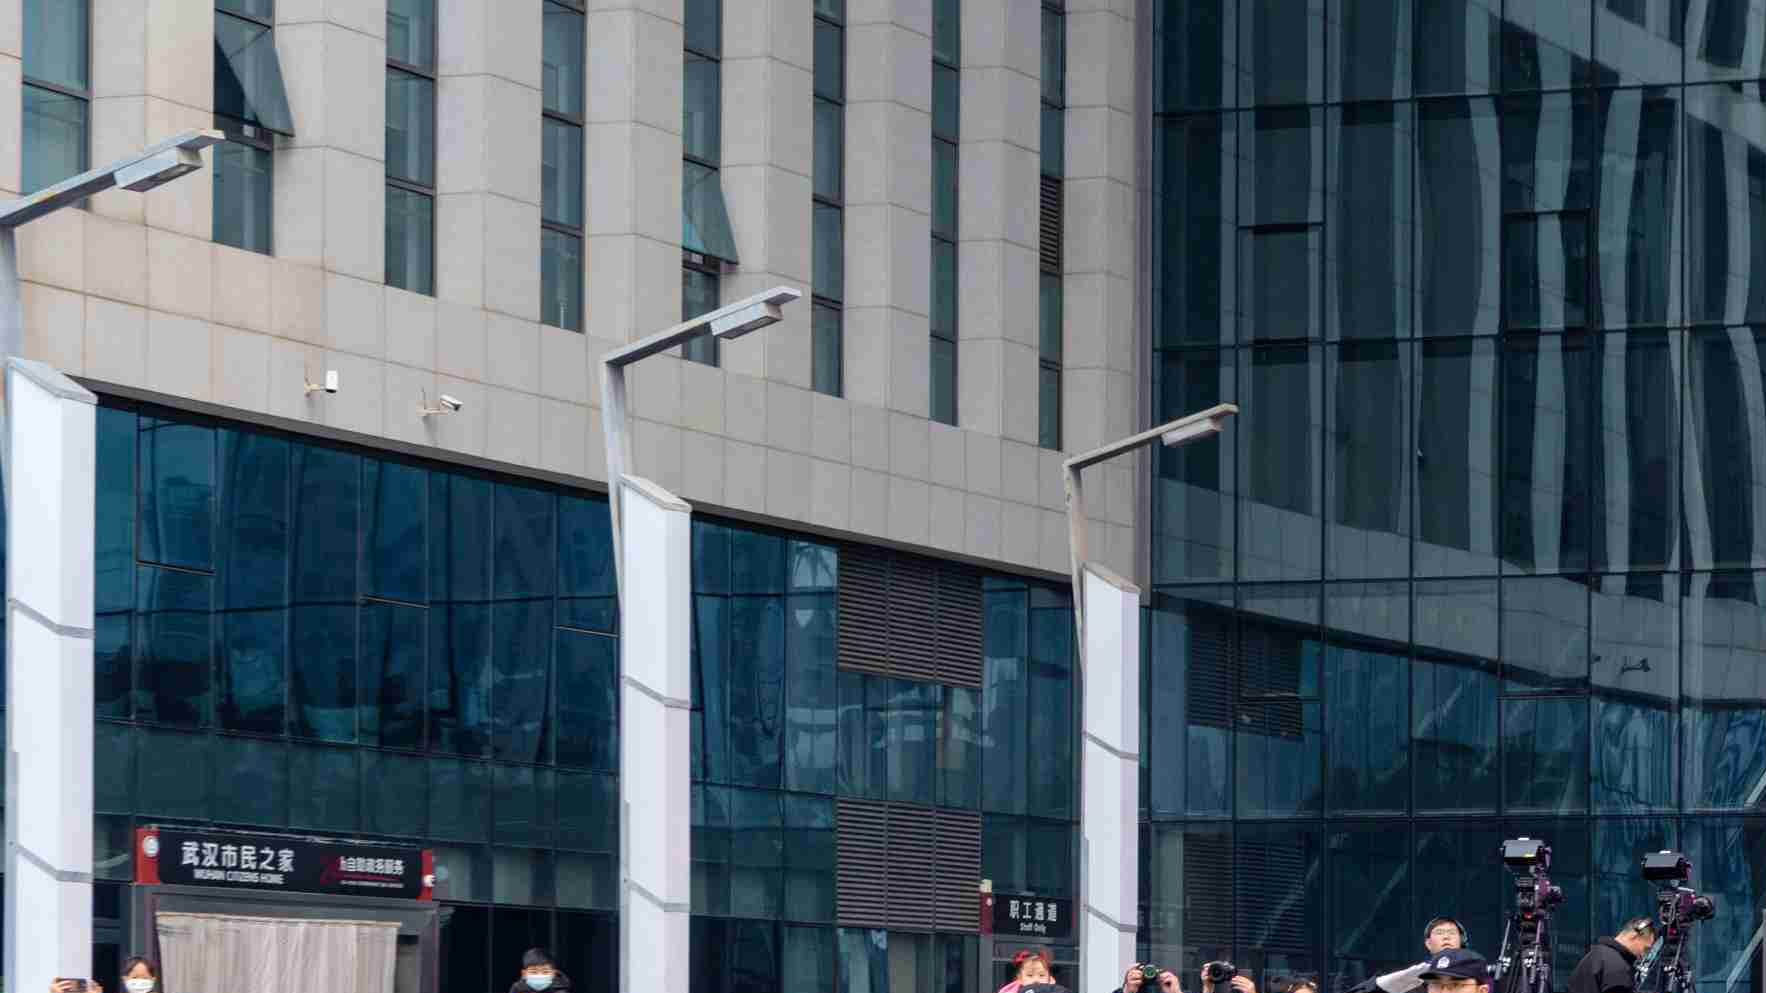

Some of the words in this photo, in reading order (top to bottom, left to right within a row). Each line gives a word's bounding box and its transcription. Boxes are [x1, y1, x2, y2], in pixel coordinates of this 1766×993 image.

[181, 840, 295, 873] 武汉市民之家
[1009, 899, 1057, 922] 职工通道
